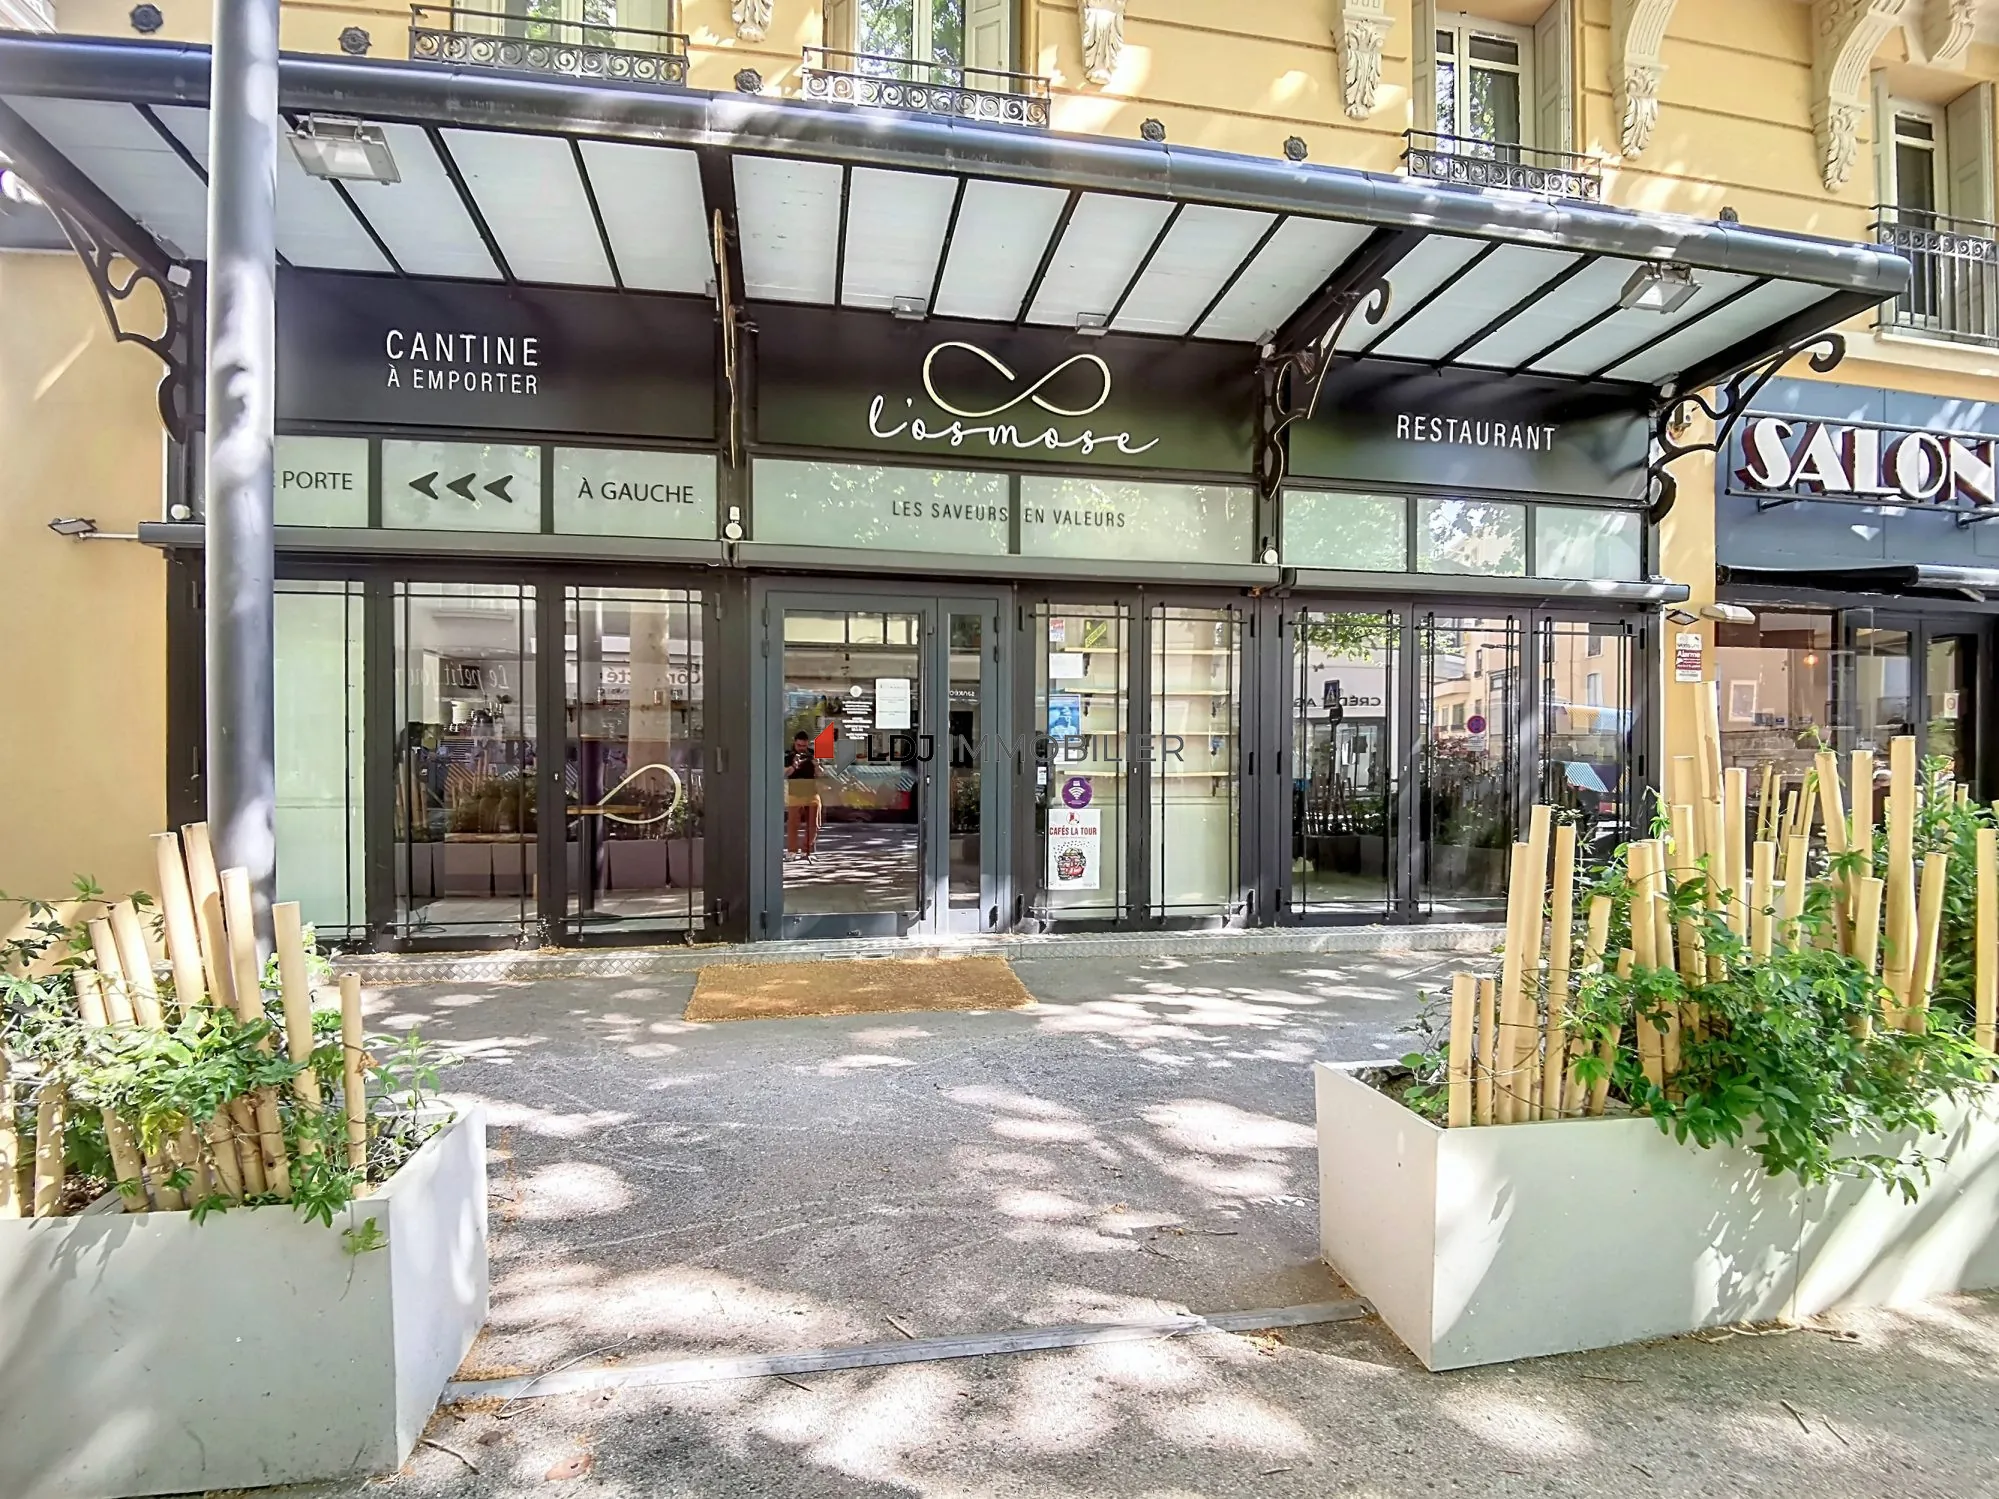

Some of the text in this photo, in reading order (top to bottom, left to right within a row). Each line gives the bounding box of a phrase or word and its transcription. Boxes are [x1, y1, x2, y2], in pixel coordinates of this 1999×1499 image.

[385, 329, 539, 367] CANTINE
[387, 363, 538, 395] À EMPORTER
[869, 395, 1160, 455] l'osmose
[1396, 413, 1557, 452] RESTAURANT
[1738, 417, 1997, 504] SALON
[282, 470, 353, 491] PORTE
[577, 476, 695, 504] À GAUCHE
[892, 500, 1126, 528] LES SAVEURS EN VALEURS
[1049, 825, 1097, 836] CAFÉS LA TOUR
